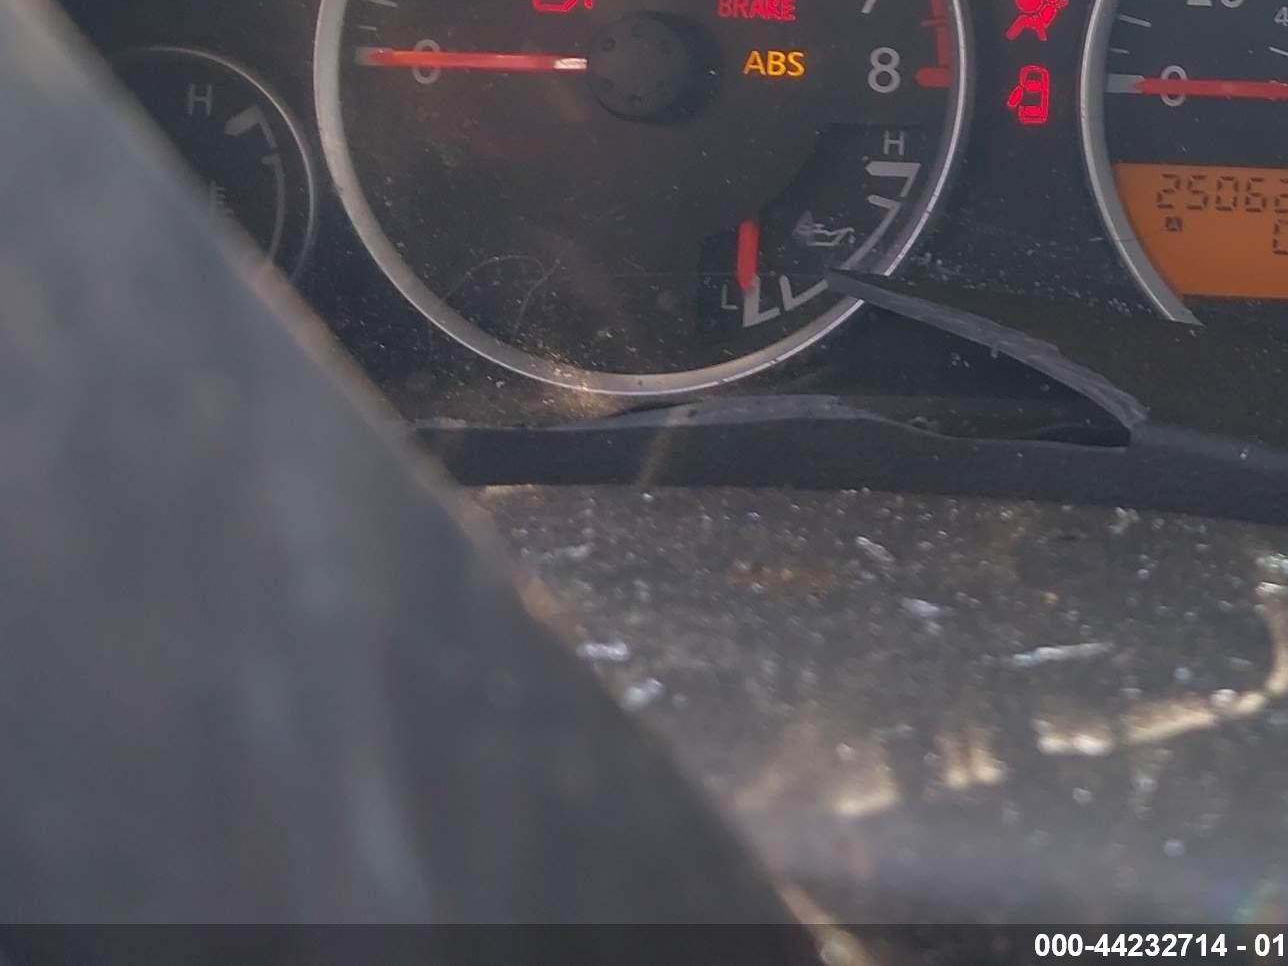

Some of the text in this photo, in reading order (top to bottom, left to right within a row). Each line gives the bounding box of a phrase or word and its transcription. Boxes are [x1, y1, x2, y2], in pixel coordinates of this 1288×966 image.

[743, 50, 806, 77] ABS
[868, 47, 900, 94] 8
[187, 83, 212, 115] H
[1161, 65, 1188, 106] 0
[884, 130, 905, 155] H
[721, 284, 739, 310] L
